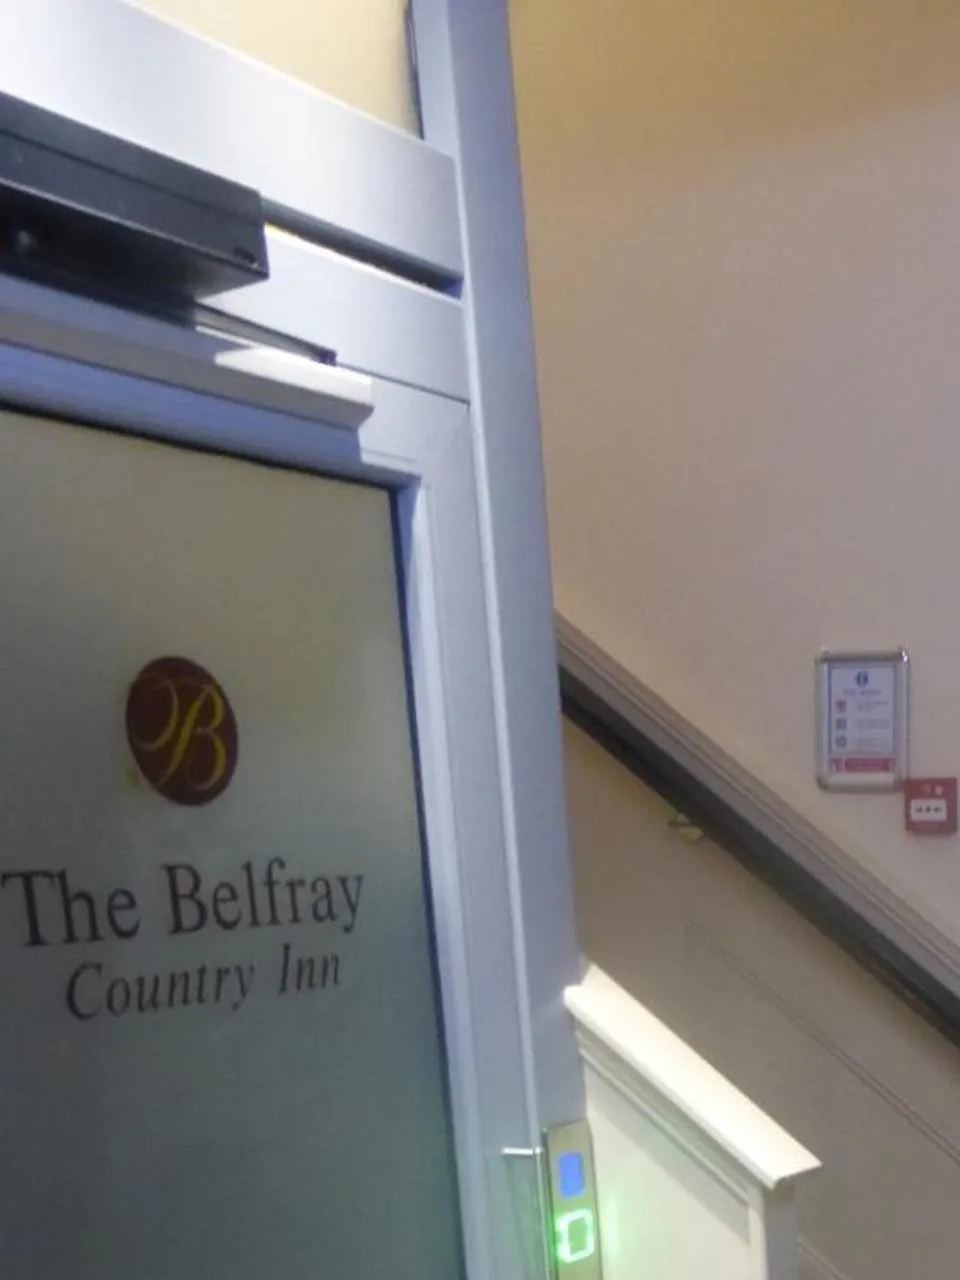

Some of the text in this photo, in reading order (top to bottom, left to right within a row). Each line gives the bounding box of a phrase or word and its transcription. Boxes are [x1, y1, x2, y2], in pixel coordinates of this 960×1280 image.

[2, 856, 365, 948] The Belfray
[66, 943, 342, 1020] Country Inn
